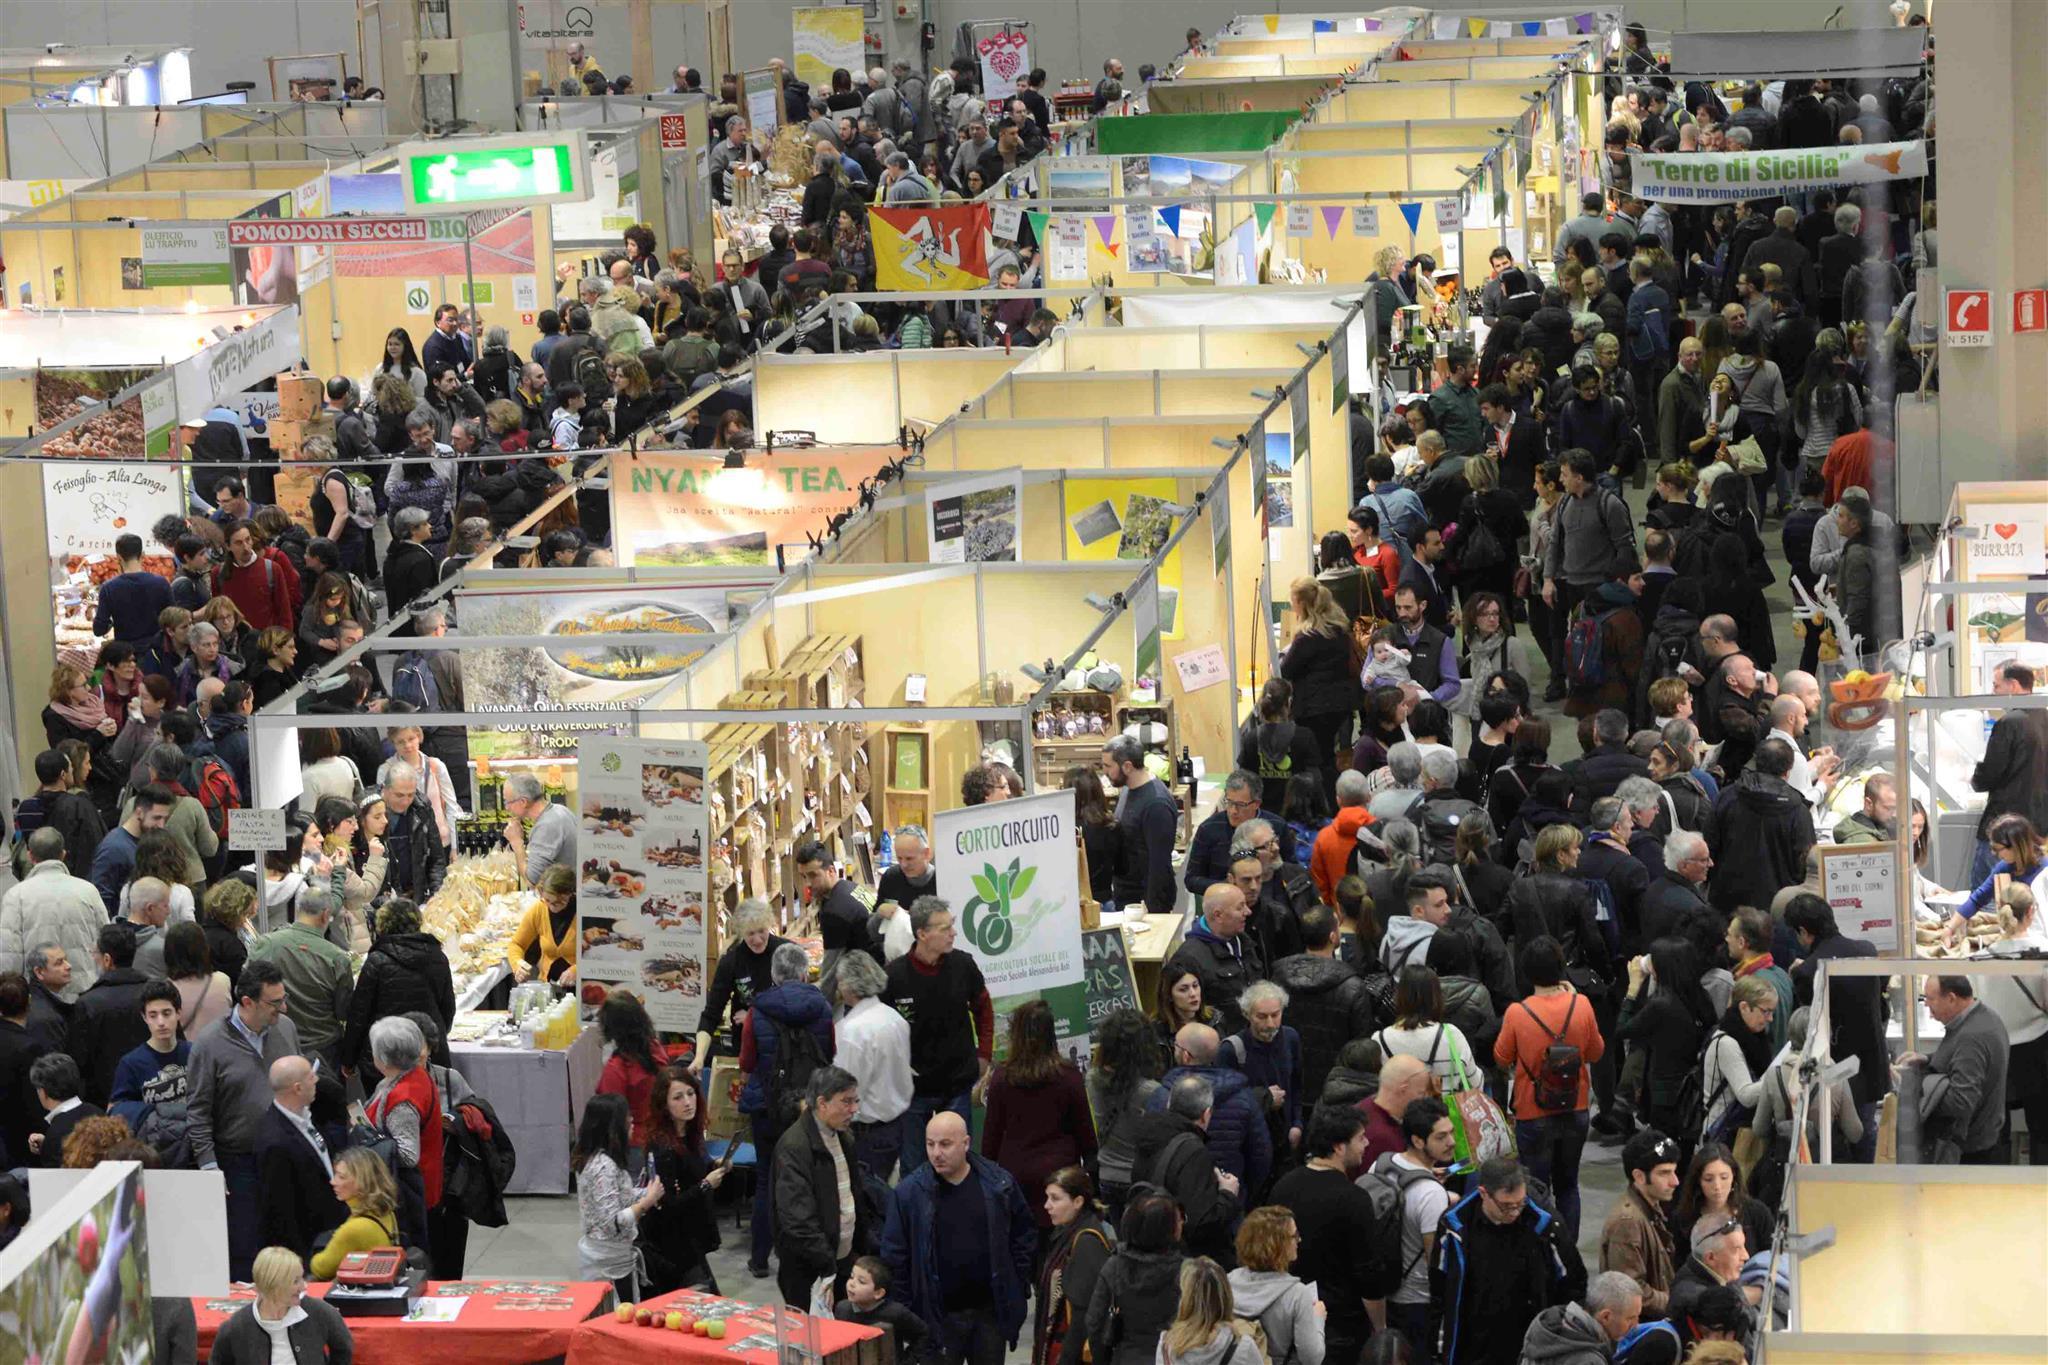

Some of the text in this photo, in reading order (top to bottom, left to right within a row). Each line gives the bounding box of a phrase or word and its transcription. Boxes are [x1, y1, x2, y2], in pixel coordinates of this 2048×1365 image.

[1725, 158, 1750, 182] di
[1643, 185, 1666, 198] per
[1669, 187, 1693, 198] una
[1696, 185, 1776, 200] promozione
[231, 218, 468, 242] POMODORI SECCHI BIO
[1960, 335, 1985, 344] 5157
[53, 469, 97, 495] Feisoglio
[106, 468, 130, 483] Alta
[132, 472, 168, 495] Langa
[778, 466, 852, 493] TEA.
[1973, 543, 2025, 557] BURRATA
[955, 814, 1060, 855] CORTOCIRCUITO
[1086, 994, 1136, 1020] ERCASI
